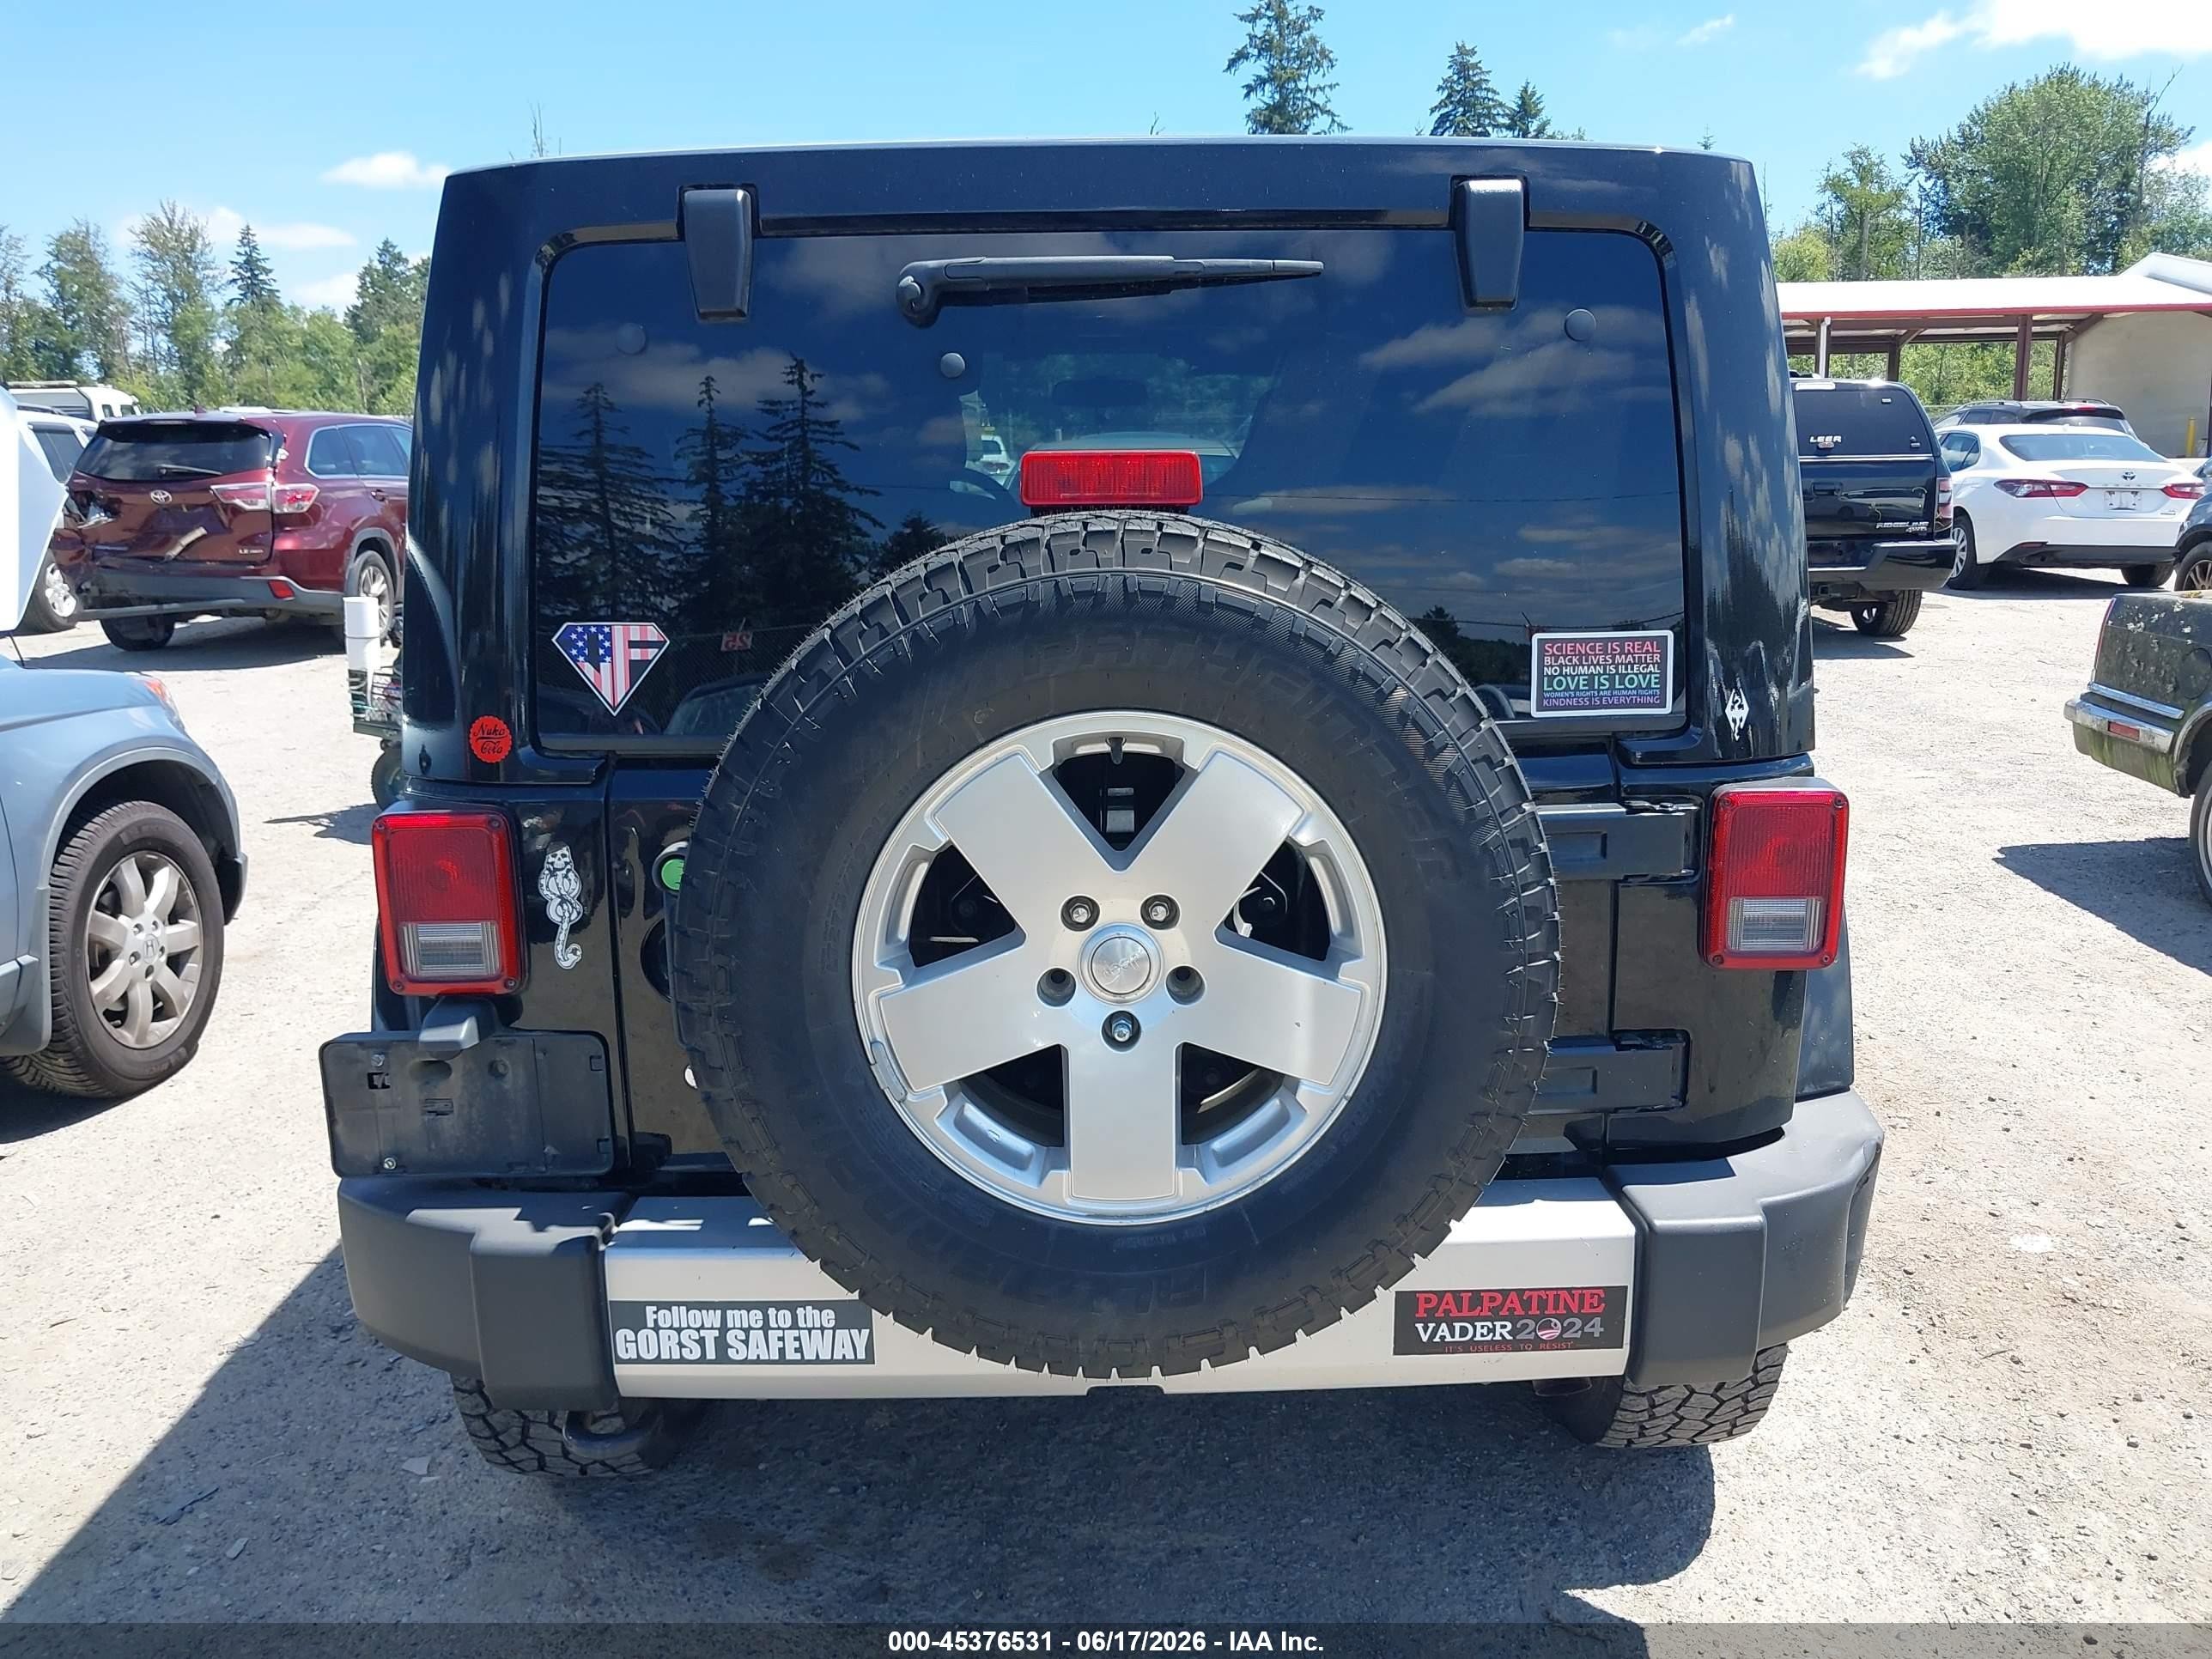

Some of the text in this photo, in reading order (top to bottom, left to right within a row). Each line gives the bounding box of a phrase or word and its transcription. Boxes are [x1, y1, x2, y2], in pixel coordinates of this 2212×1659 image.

[1544, 641, 1662, 655] SCIENCE IS REAL
[1544, 653, 1661, 665] BLACK LIVES MATTER
[1543, 664, 1661, 676] NO HUMAN IS ILLEGAL
[1543, 673, 1661, 691] LOVE IS LOVE
[1543, 696, 1661, 707] KINDNESS IS EVERYTHING
[1414, 1289, 1607, 1318] PALPATINE
[645, 1305, 836, 1328] Follow me to the
[1414, 1321, 1514, 1343] VADER
[615, 1328, 871, 1361] GORST SAFEWAY
[1469, 1344, 1512, 1352] USELESS
[1539, 1341, 1572, 1350] RESIST
